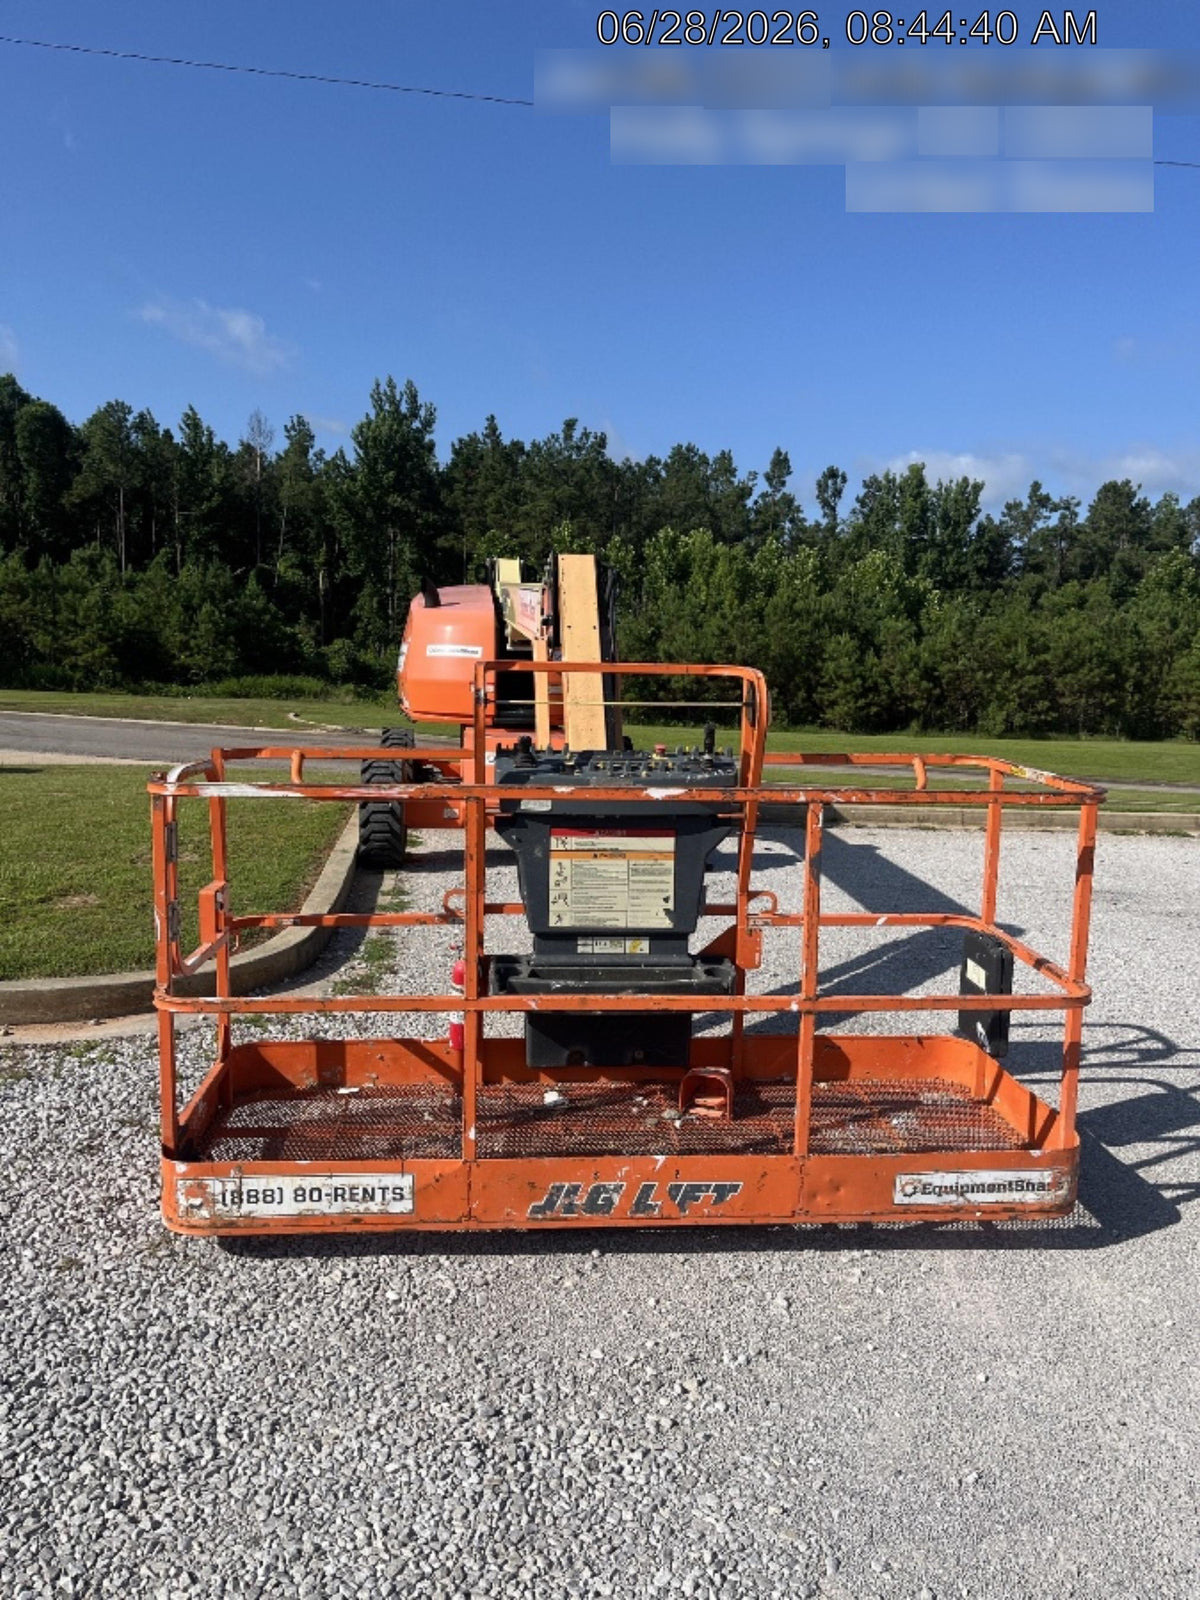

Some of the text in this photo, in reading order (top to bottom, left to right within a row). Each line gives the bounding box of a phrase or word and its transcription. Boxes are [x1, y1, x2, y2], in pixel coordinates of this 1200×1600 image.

[293, 1186, 405, 1203] 80-RENTS
[921, 1180, 1064, 1197] EquipmentSha
[526, 1182, 626, 1217] JLG
